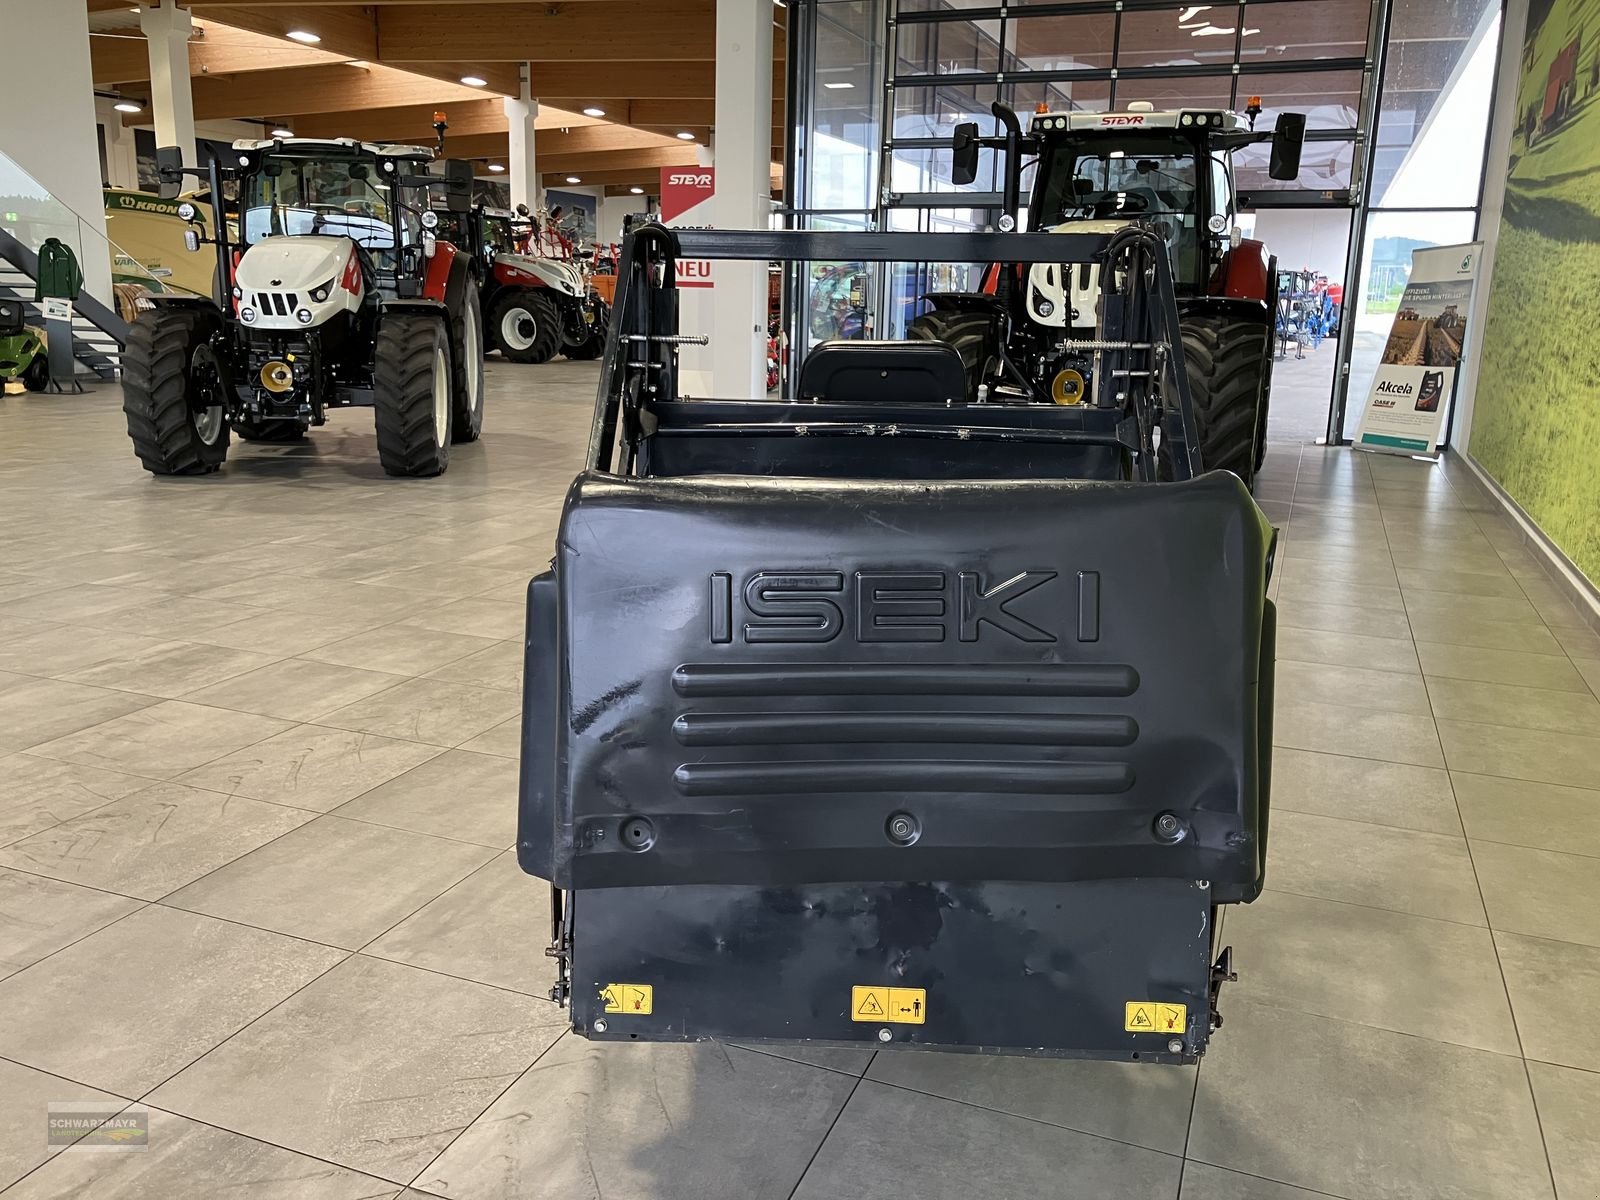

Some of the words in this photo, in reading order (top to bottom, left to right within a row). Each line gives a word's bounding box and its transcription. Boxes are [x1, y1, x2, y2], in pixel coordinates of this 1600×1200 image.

[1101, 116, 1144, 126] STEYR
[668, 174, 712, 185] STEYR
[135, 201, 179, 214] KRON
[675, 261, 710, 277] NEU
[1376, 381, 1413, 395] Akcela
[710, 571, 1100, 642] ISEKI
